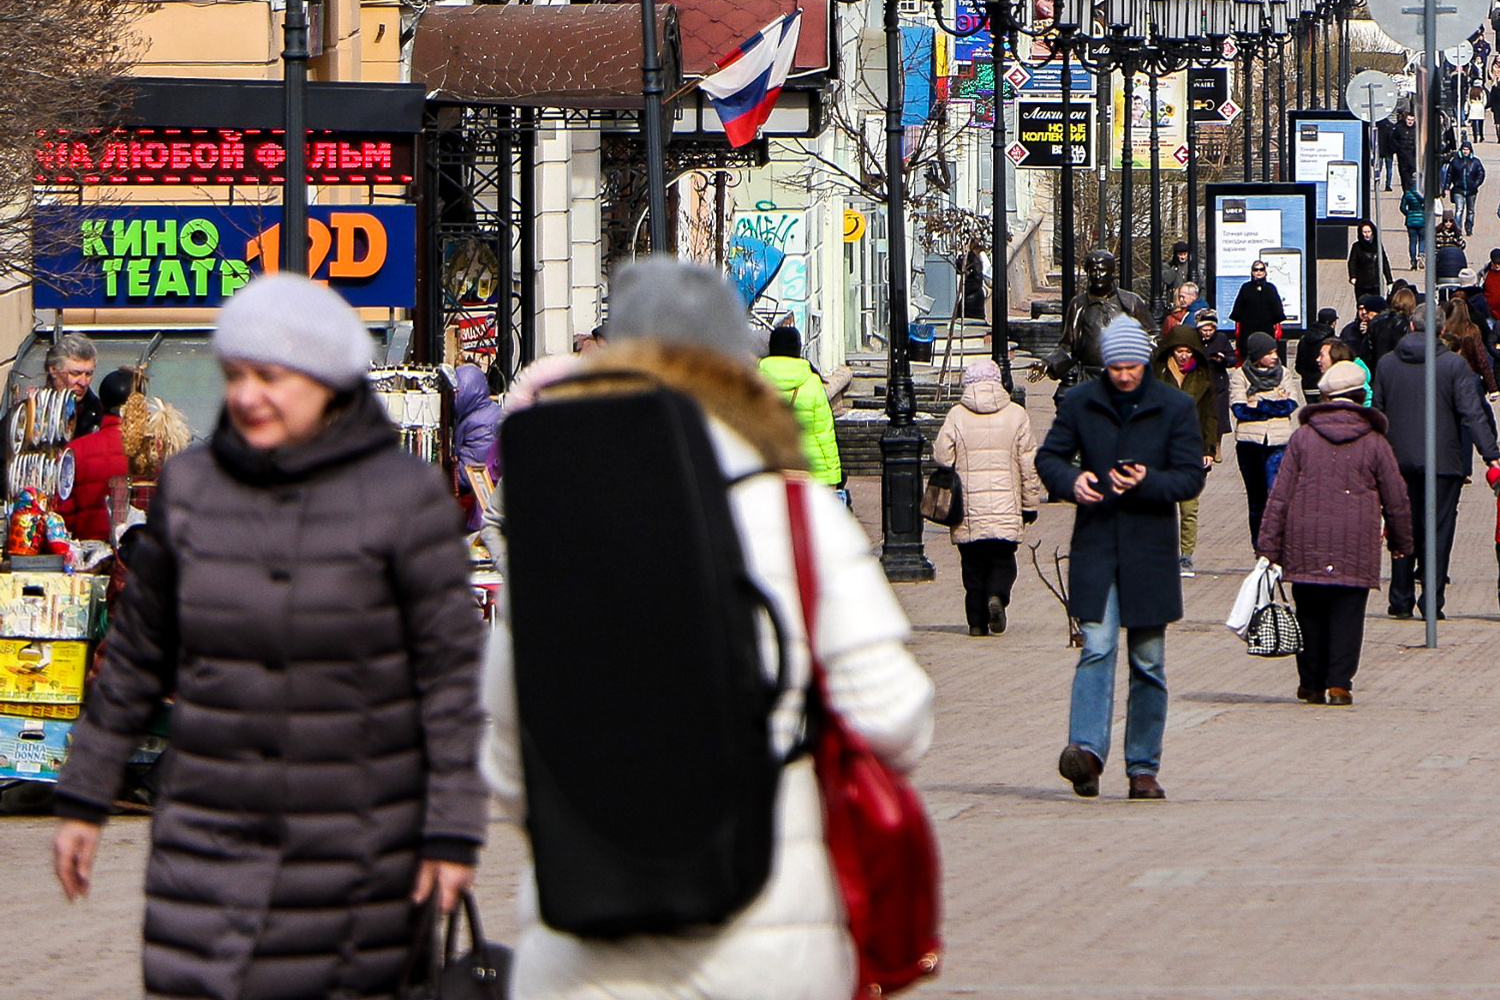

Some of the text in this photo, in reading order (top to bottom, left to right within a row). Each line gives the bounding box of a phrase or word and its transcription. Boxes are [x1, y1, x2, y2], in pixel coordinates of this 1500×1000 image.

[1048, 123, 1087, 133] НОЫЕ
[1022, 132, 1087, 142] КОЛЛЕКИИ
[105, 132, 246, 169] ЛЮБОЙ
[256, 141, 392, 169] ФЛЬМ
[82, 218, 220, 258] КИНО
[102, 258, 252, 297] ТЕАТР
[15, 743, 46, 752] PRIMA
[14, 752, 46, 761] DONNA
